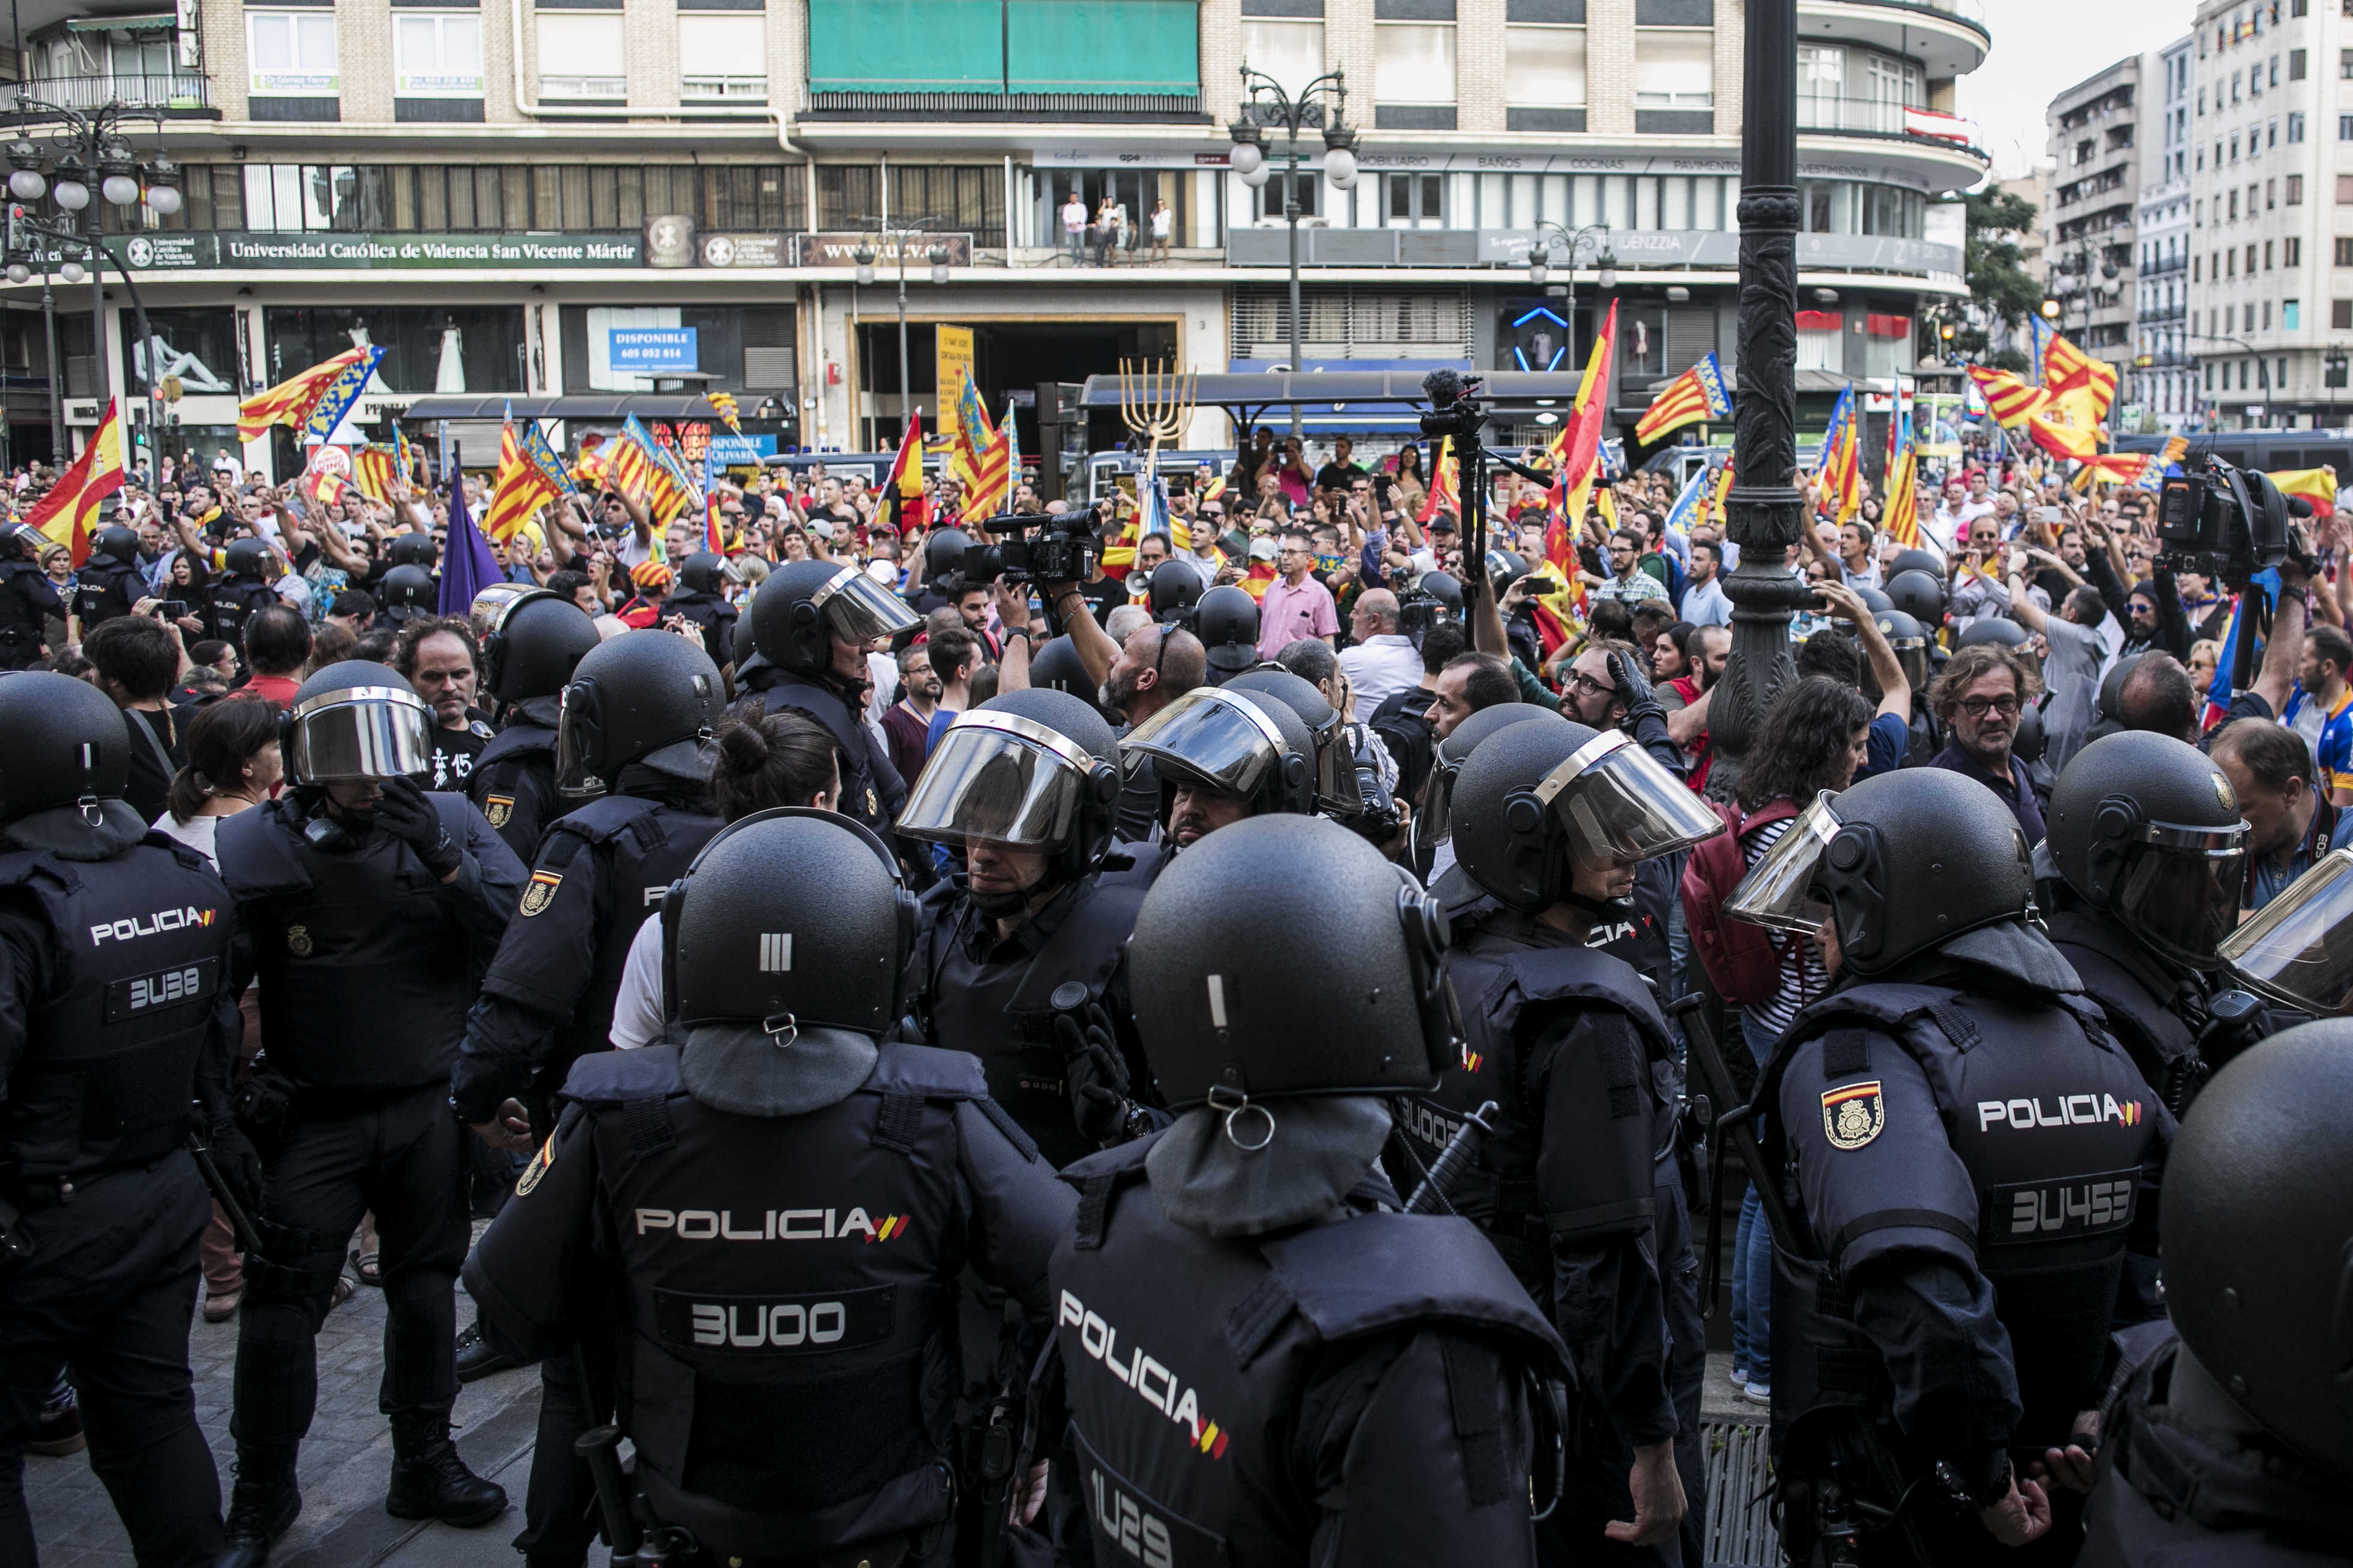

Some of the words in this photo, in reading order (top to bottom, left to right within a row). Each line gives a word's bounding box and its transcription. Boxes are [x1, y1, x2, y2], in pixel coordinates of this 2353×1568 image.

[1357, 155, 1429, 166] MOBILIARIO
[1478, 155, 1522, 168] BAÑOS
[1571, 157, 1625, 169] COCINAS
[1673, 159, 1741, 172] PAVIMENTO
[230, 242, 327, 258] Universidad
[330, 242, 397, 258] Católica
[400, 243, 421, 258] de
[422, 243, 489, 259] Valencia
[492, 243, 521, 259] San
[522, 244, 583, 259] Vicente
[586, 242, 635, 259] Mártir
[1199, 320, 1206, 331] 3
[616, 333, 688, 344] DISPONIBLE
[621, 348, 640, 358] 605
[823, 348, 829, 359] 2
[317, 454, 343, 466] BURGER
[319, 461, 345, 472] KING
[451, 752, 472, 778] 15
[2315, 834, 2328, 859] EOS
[91, 906, 203, 946] POLICIA
[1977, 1093, 2125, 1132] POLICIA
[635, 1207, 876, 1240] POLICIA
[1059, 1289, 1199, 1440] POLICIA
